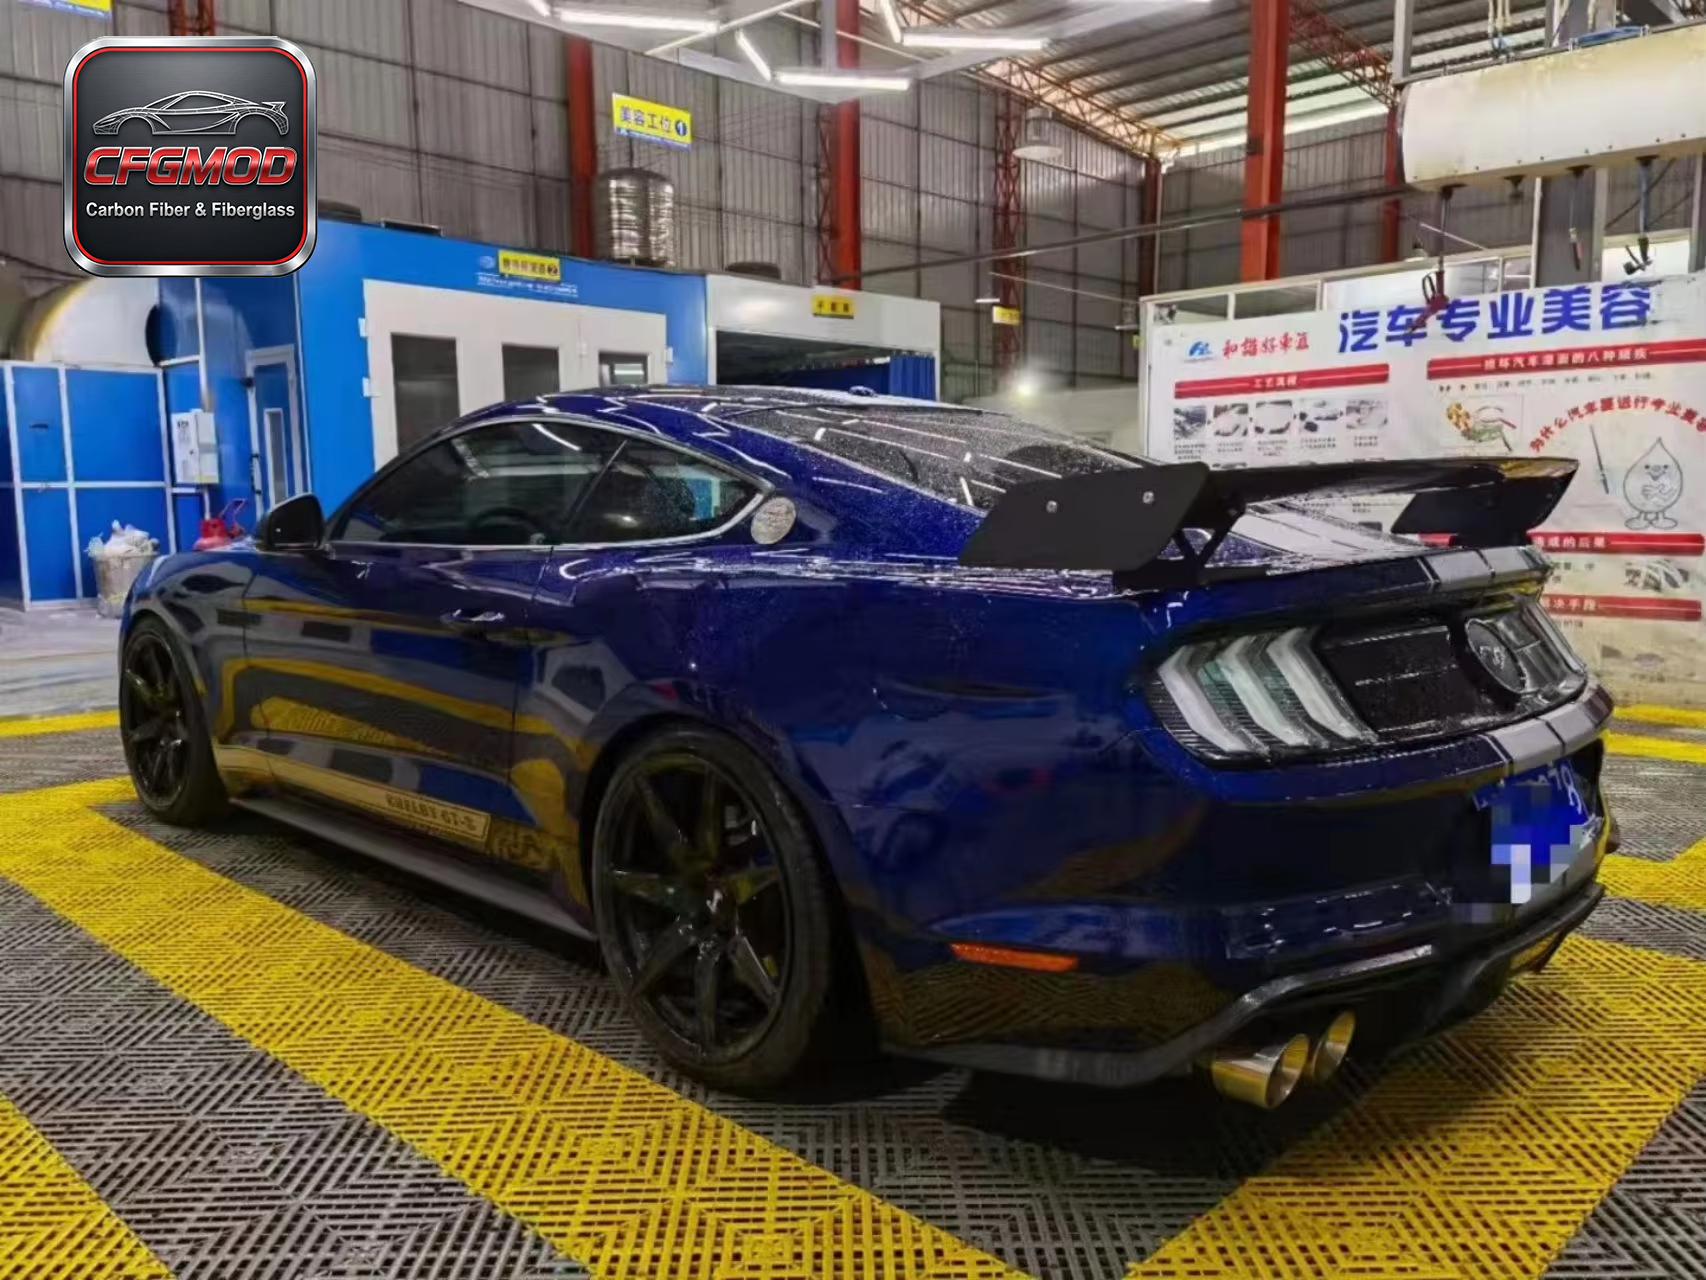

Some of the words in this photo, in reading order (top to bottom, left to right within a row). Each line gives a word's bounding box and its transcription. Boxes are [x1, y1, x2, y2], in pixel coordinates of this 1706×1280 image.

[1339, 285, 1650, 353] 汽车专业美容
